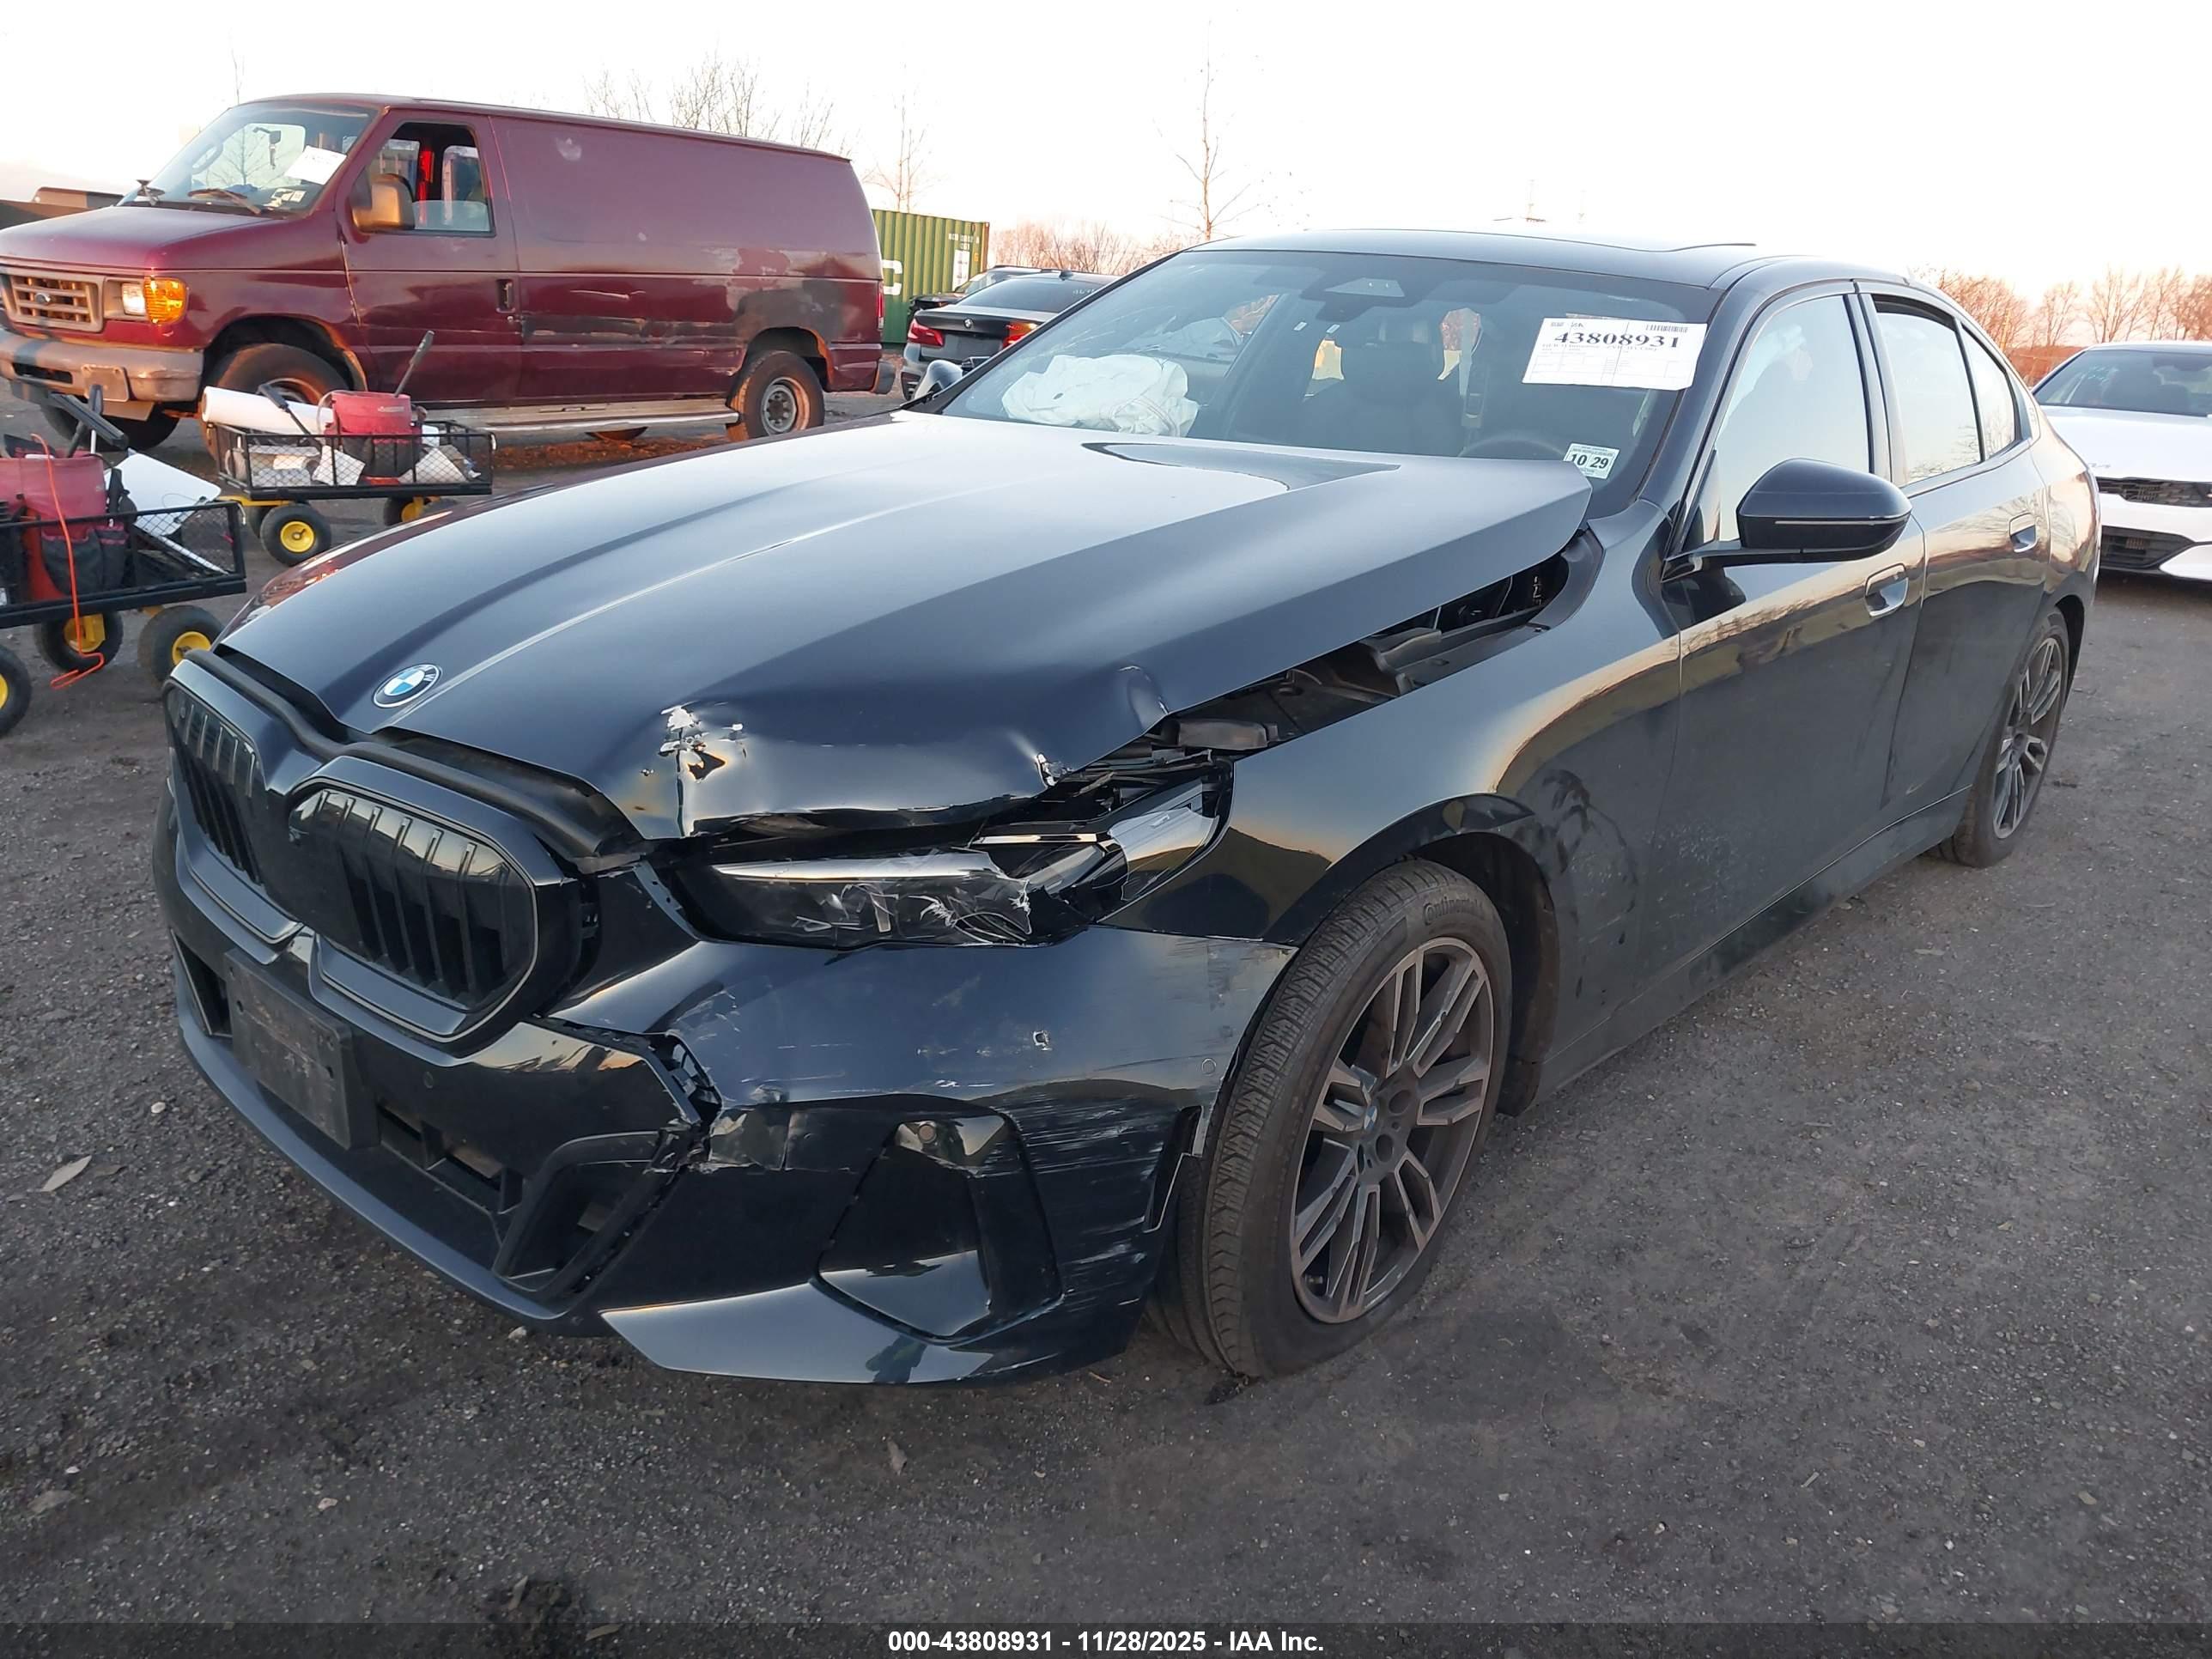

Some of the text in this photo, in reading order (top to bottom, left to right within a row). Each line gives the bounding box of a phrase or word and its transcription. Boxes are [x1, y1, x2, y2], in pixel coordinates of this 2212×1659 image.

[1554, 331, 1680, 349] 43808931
[1571, 453, 1609, 469] 10 29
